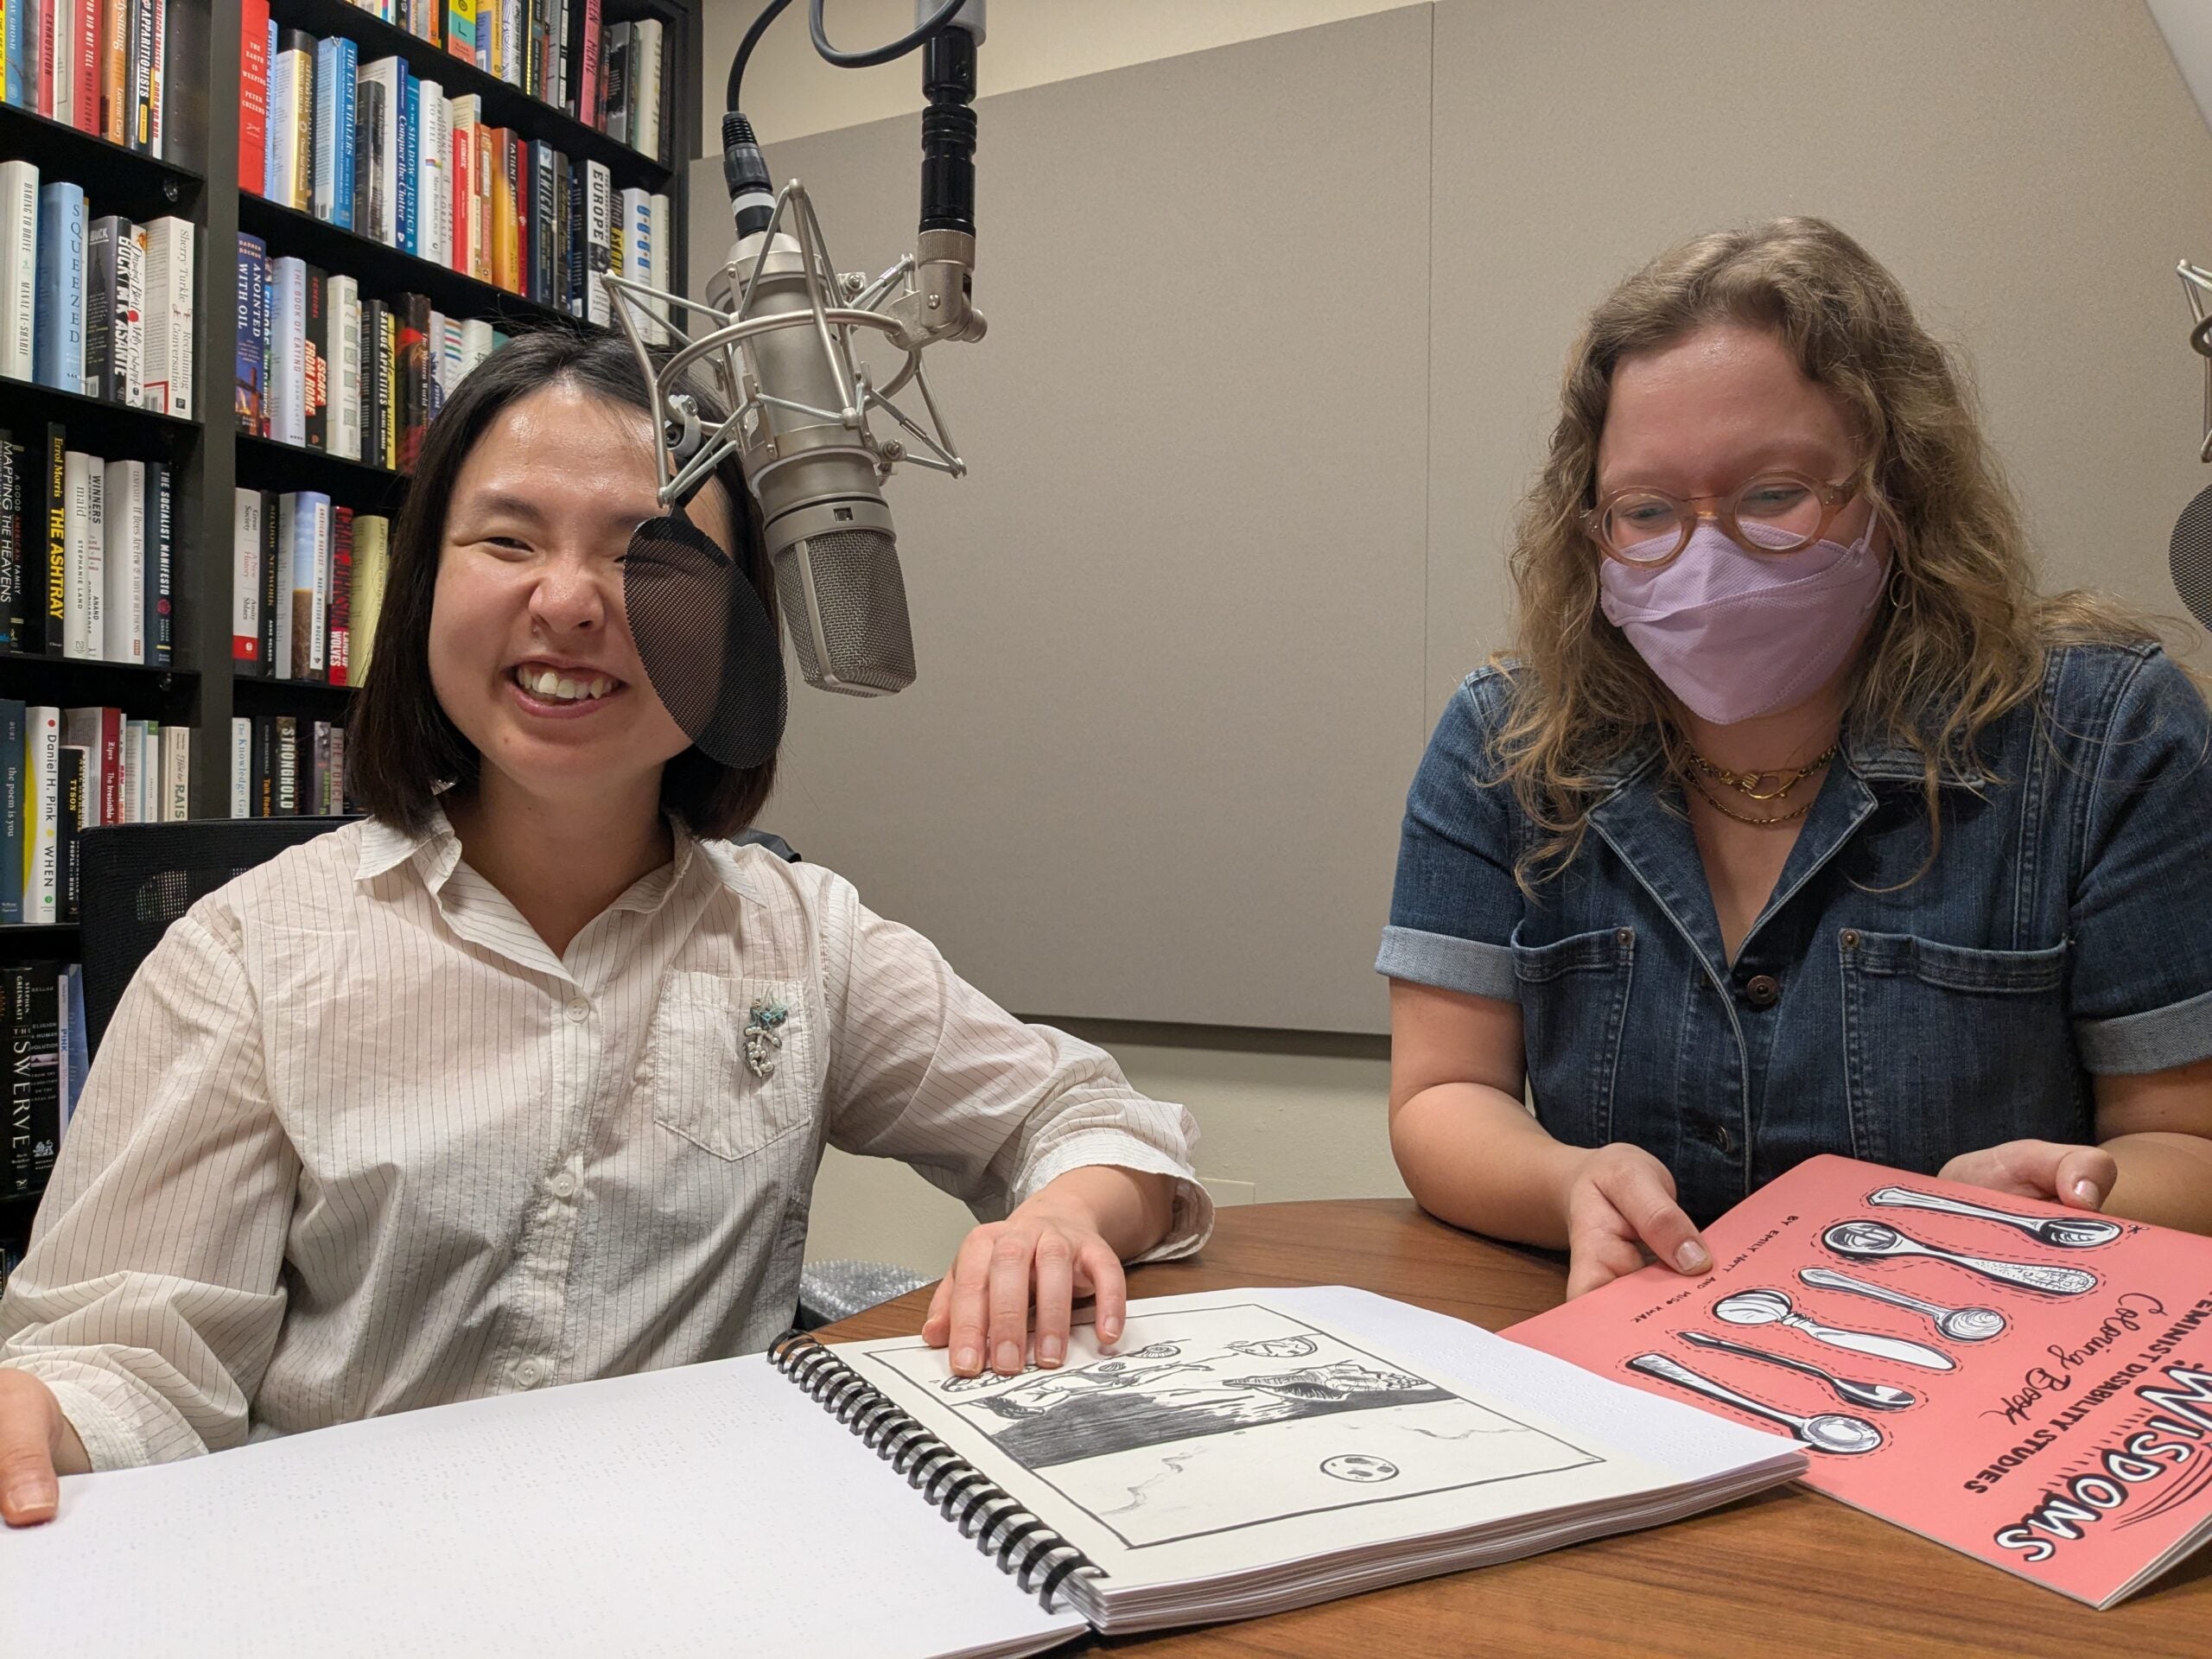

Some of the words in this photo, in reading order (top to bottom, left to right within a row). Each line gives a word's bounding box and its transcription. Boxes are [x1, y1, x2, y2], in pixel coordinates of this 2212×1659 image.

[86, 15, 94, 29] DID
[86, 31, 94, 47] NOT
[45, 13, 54, 76] EXHAUSTION
[86, 50, 94, 67] TELL
[140, 10, 151, 98] APPARITIONISTS
[245, 51, 264, 64] EARTH
[249, 41, 261, 52] THE
[586, 39, 598, 75] MERYL
[242, 70, 267, 86] WEEPING
[116, 87, 124, 117] Lorene
[242, 100, 265, 115] COZZENS
[245, 91, 263, 104] PETER
[114, 118, 124, 140] Cary
[345, 104, 353, 155] WHALERS
[397, 115, 407, 162] Conquer
[407, 125, 416, 177] SHADOW
[397, 162, 406, 180] the
[23, 182, 33, 214] DARING
[397, 181, 406, 221] Clutter
[406, 186, 415, 235] JUSTICE
[593, 169, 604, 240] EUROPE
[23, 216, 32, 226] TO
[90, 227, 109, 243] BUCK
[22, 228, 31, 252] DRIVE
[118, 236, 131, 275] BUCK
[179, 229, 189, 264] Sherry
[70, 204, 82, 343] SQUEEZED
[130, 245, 142, 282] Drawing
[21, 282, 30, 308] MANAL
[178, 268, 189, 303] Turkle
[238, 263, 249, 302] WITH
[238, 304, 248, 329] OIL
[252, 264, 262, 337] ANOINTED
[19, 311, 29, 357] AL-SHARIF
[295, 321, 302, 332] OF
[115, 320, 128, 377] ASANTE
[171, 323, 181, 391] Conversation
[181, 332, 192, 390] Reclaiming
[305, 340, 316, 378] FROM
[316, 357, 327, 405] ESCAPE
[379, 351, 388, 405] APPETITES
[305, 379, 316, 415] ROME
[54, 437, 63, 464] Errol
[3, 441, 13, 511] MAPPING
[53, 465, 63, 498] Morris
[161, 472, 169, 487] THE
[76, 486, 86, 517] maid
[92, 475, 101, 524] WINNERS
[160, 492, 169, 540] SOCIALIST
[2, 514, 12, 535] THE
[50, 508, 65, 538] THE
[133, 516, 142, 535] Bees
[133, 537, 142, 550] Are
[133, 551, 142, 565] Few
[1, 537, 12, 603] HEAVENS
[49, 543, 64, 620] ASHTRAY
[160, 544, 169, 594] MANIFESTO
[332, 563, 352, 629] JOHNSON
[329, 631, 341, 666] WOLVES
[47, 734, 57, 774] Daniel
[333, 736, 343, 757] THE
[236, 738, 247, 795] Knowledge
[280, 728, 295, 809] STRONGHOLD
[333, 764, 343, 804] FORCE
[5, 784, 15, 809] poem
[46, 779, 56, 790] H.
[175, 784, 185, 818] RAIS
[45, 796, 56, 821] Pink
[5, 820, 14, 837] you
[44, 846, 54, 887] WHEN
[12, 1040, 30, 1149] SWERVE
[1781, 1215, 1799, 1226] BY
[1747, 1230, 1779, 1253] EMILY
[1722, 1254, 1748, 1273] NOTT
[1666, 1291, 1691, 1305] MISO
[1697, 1275, 1716, 1289] AND
[1630, 1306, 1663, 1324] KWAK
[2047, 1293, 2168, 1370] Coloring
[2138, 1292, 2212, 1363] EMINIST
[1978, 1367, 2071, 1425] Book
[2049, 1363, 2149, 1432] DISABILITY
[1963, 1428, 2057, 1494] STUDIES
[1993, 1364, 2212, 1562] WISDOMS
